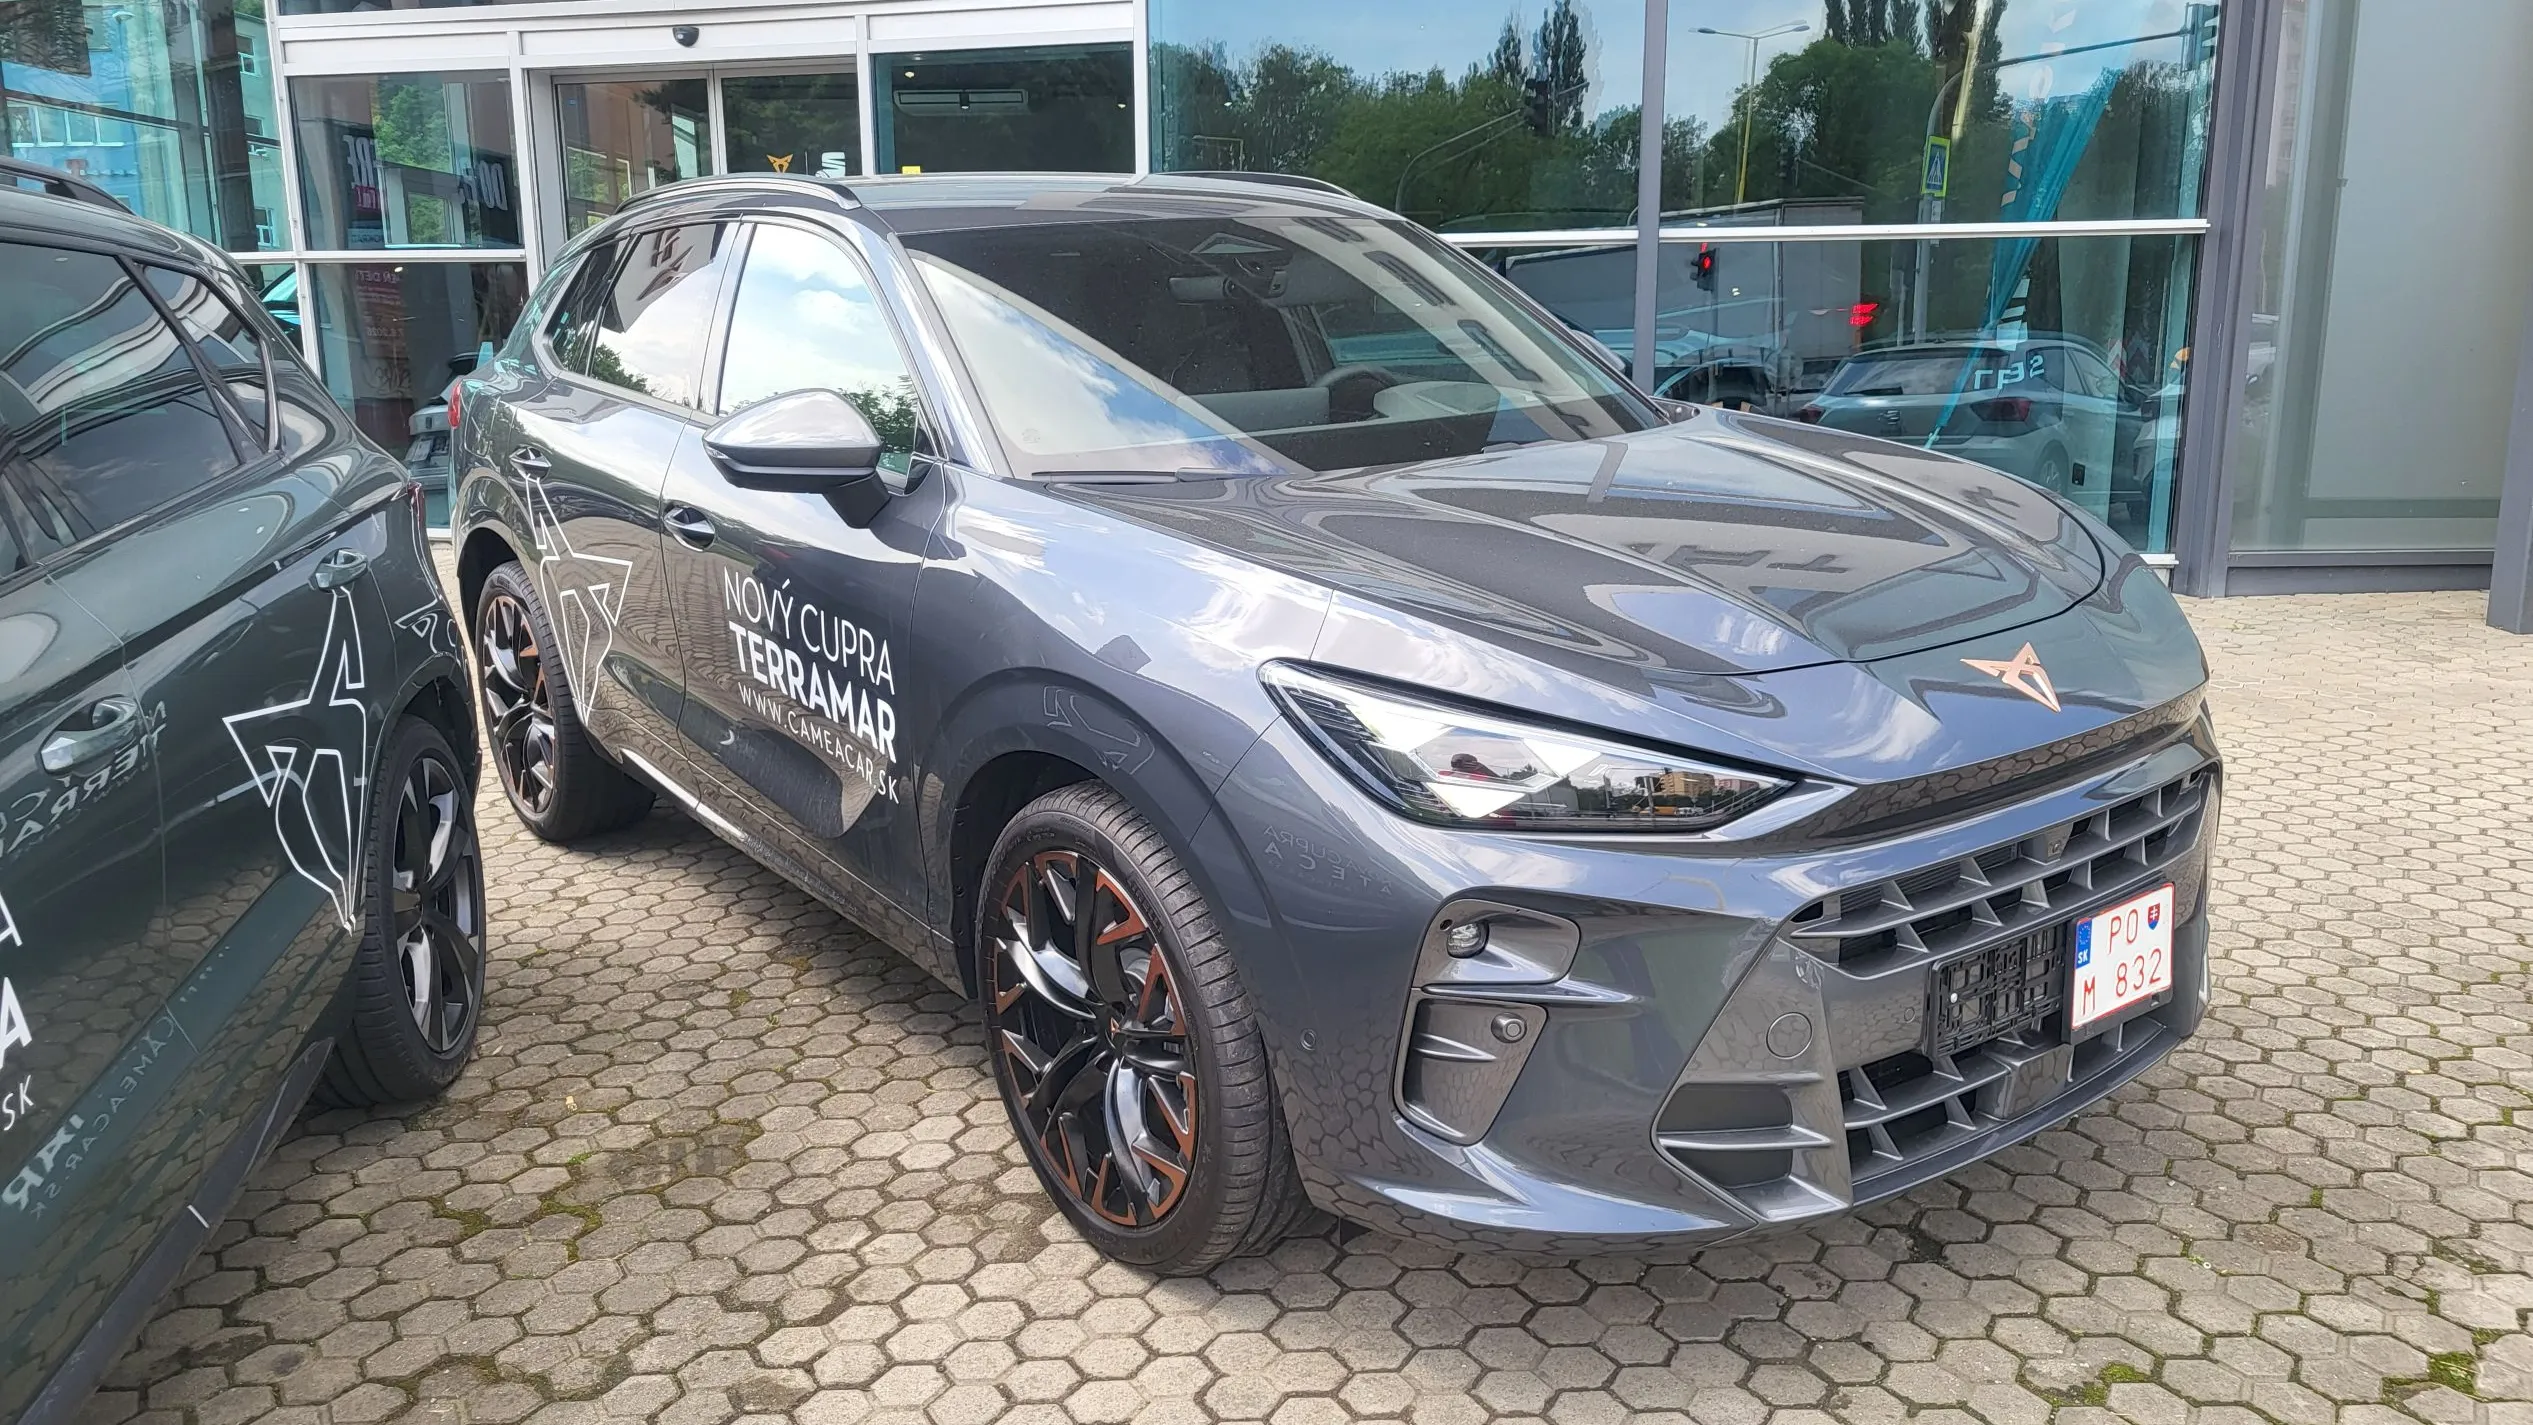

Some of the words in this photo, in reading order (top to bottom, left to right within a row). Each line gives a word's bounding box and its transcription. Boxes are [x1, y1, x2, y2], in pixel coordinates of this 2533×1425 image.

[724, 565, 794, 640] NOVÝ
[800, 603, 895, 696] CUPRA
[729, 620, 897, 764] TERRAMAR
[738, 681, 900, 805] WWW.CAMEACAR.SK
[2077, 950, 2088, 965] SK
[2108, 908, 2138, 955] PO
[2082, 975, 2096, 1016] M
[2115, 947, 2162, 998] 832
